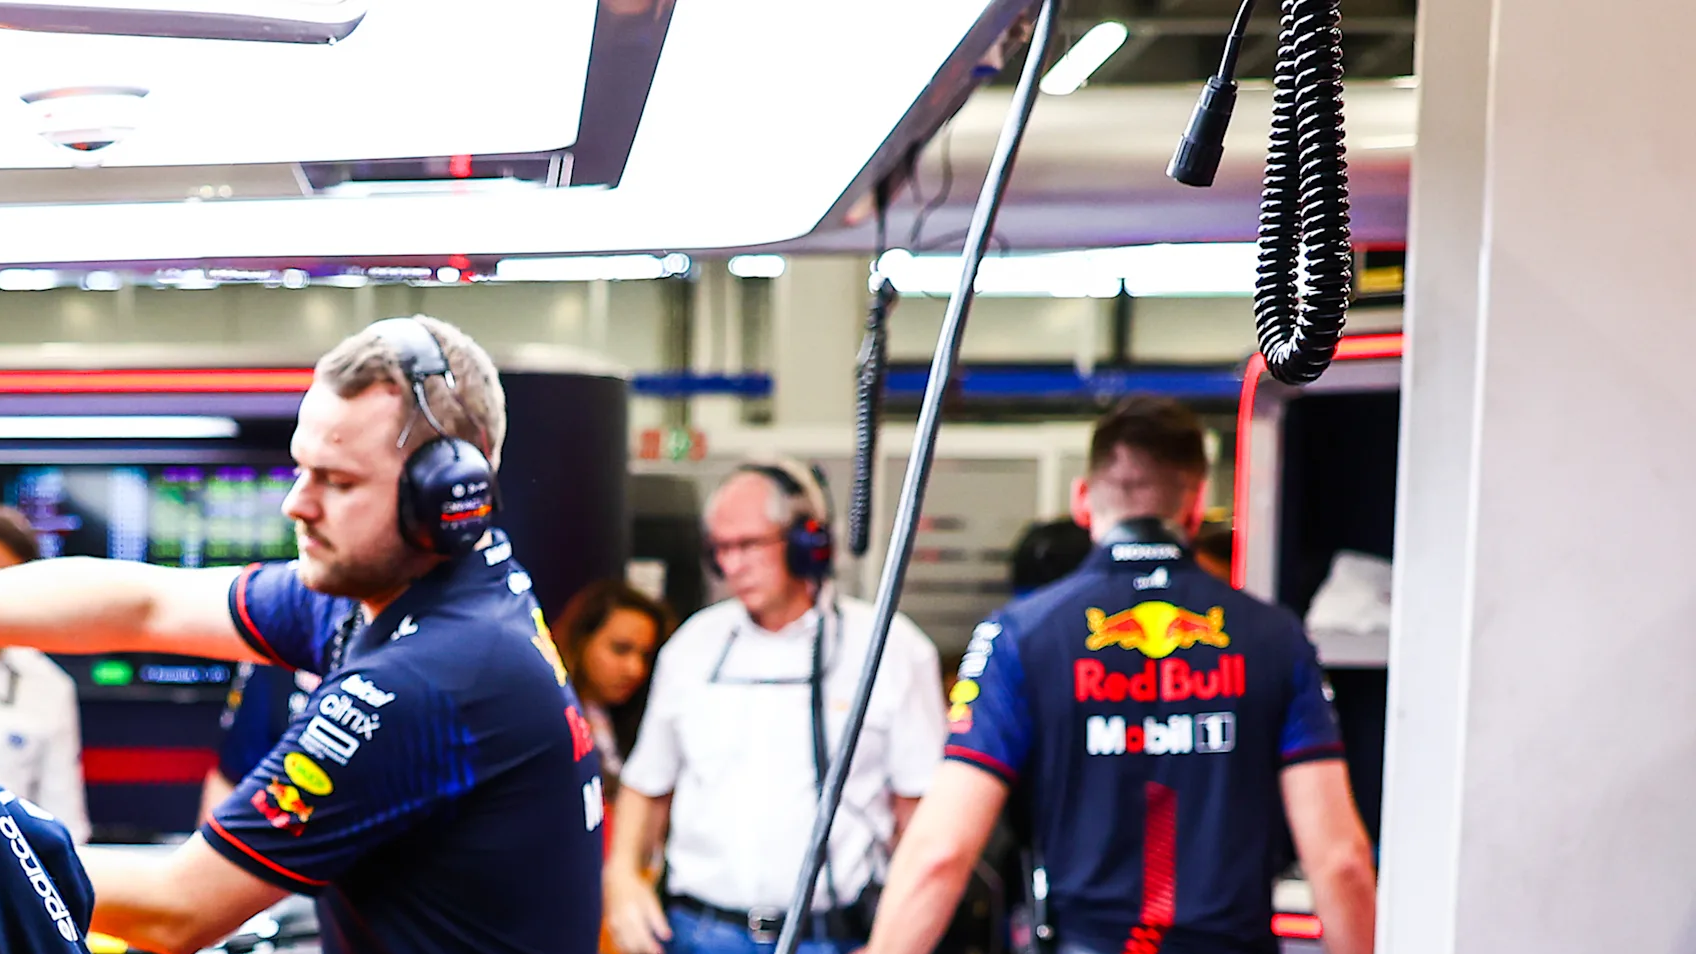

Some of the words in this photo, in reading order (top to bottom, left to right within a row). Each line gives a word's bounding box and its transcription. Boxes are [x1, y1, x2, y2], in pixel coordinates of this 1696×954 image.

[1073, 657, 1156, 702] Red
[1161, 653, 1246, 700] Bull
[1086, 715, 1192, 756] Mobil
